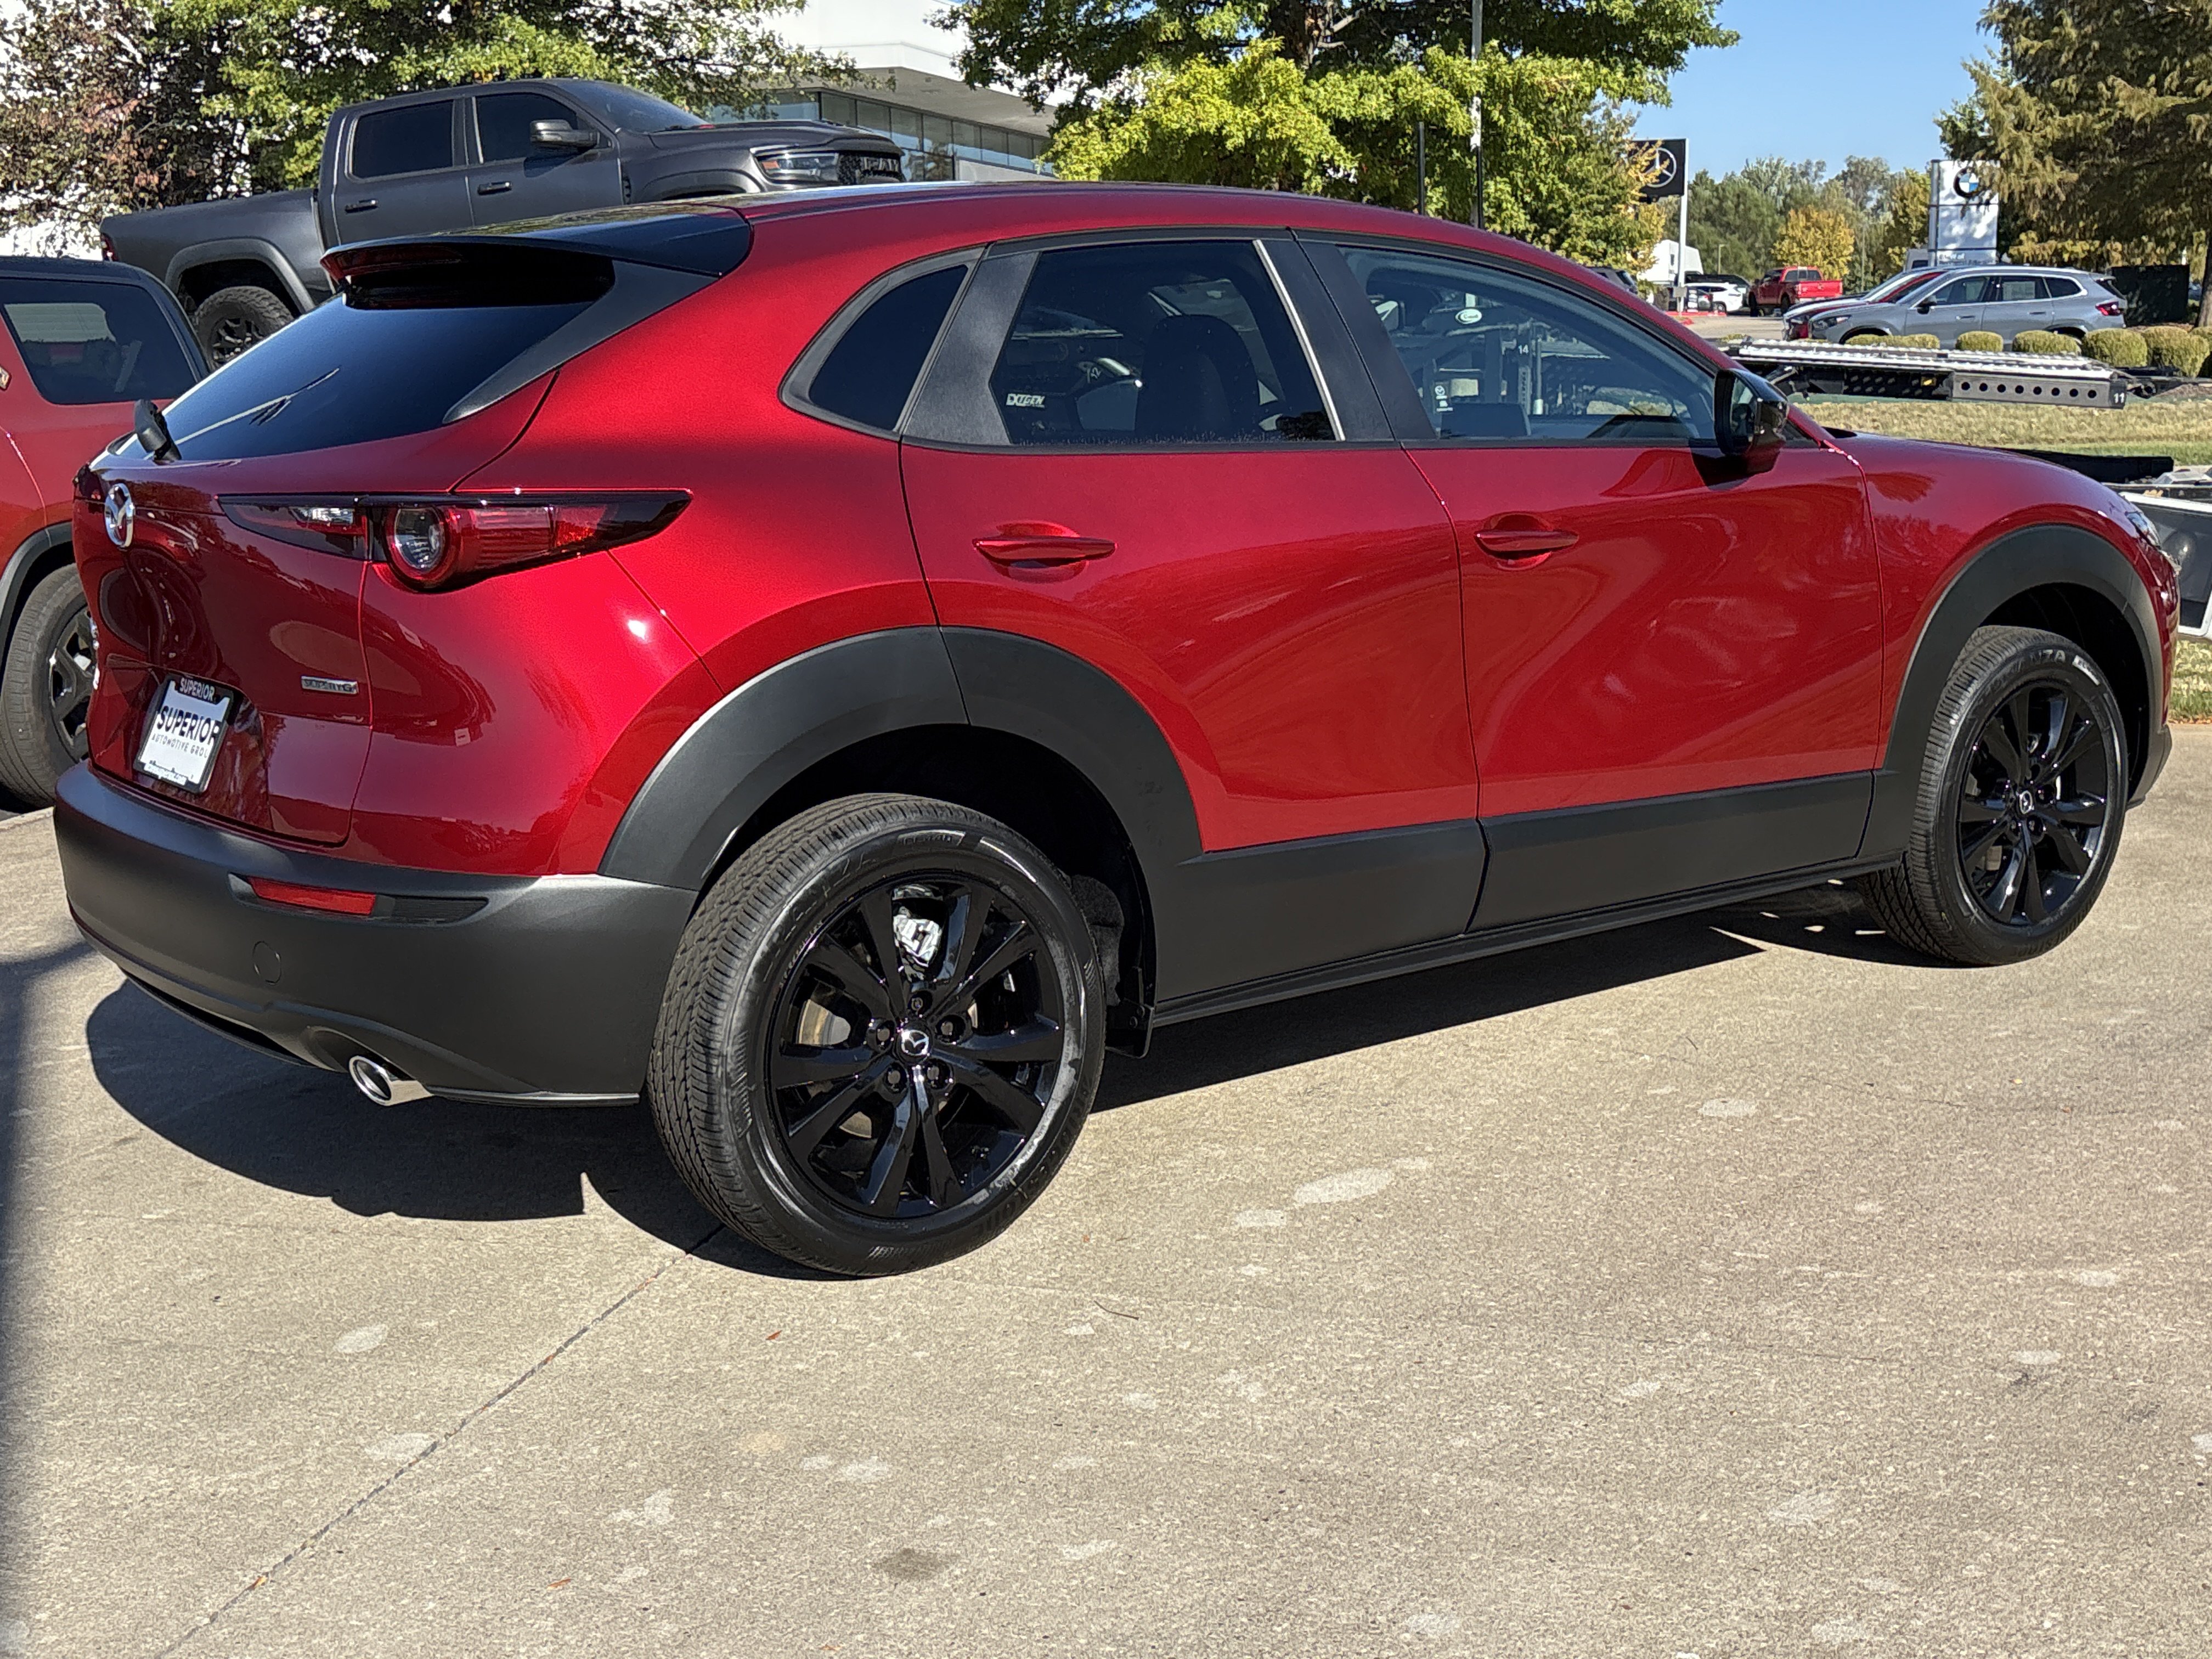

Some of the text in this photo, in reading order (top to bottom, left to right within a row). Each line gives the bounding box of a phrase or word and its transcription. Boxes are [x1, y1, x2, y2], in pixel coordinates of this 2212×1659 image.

[1518, 344, 1530, 355] 14
[2113, 392, 2125, 404] 11
[179, 677, 215, 702] SUPERIOR
[156, 705, 221, 746] SUPERIOR
[151, 733, 208, 759] AUTOMOTIVE GROU
